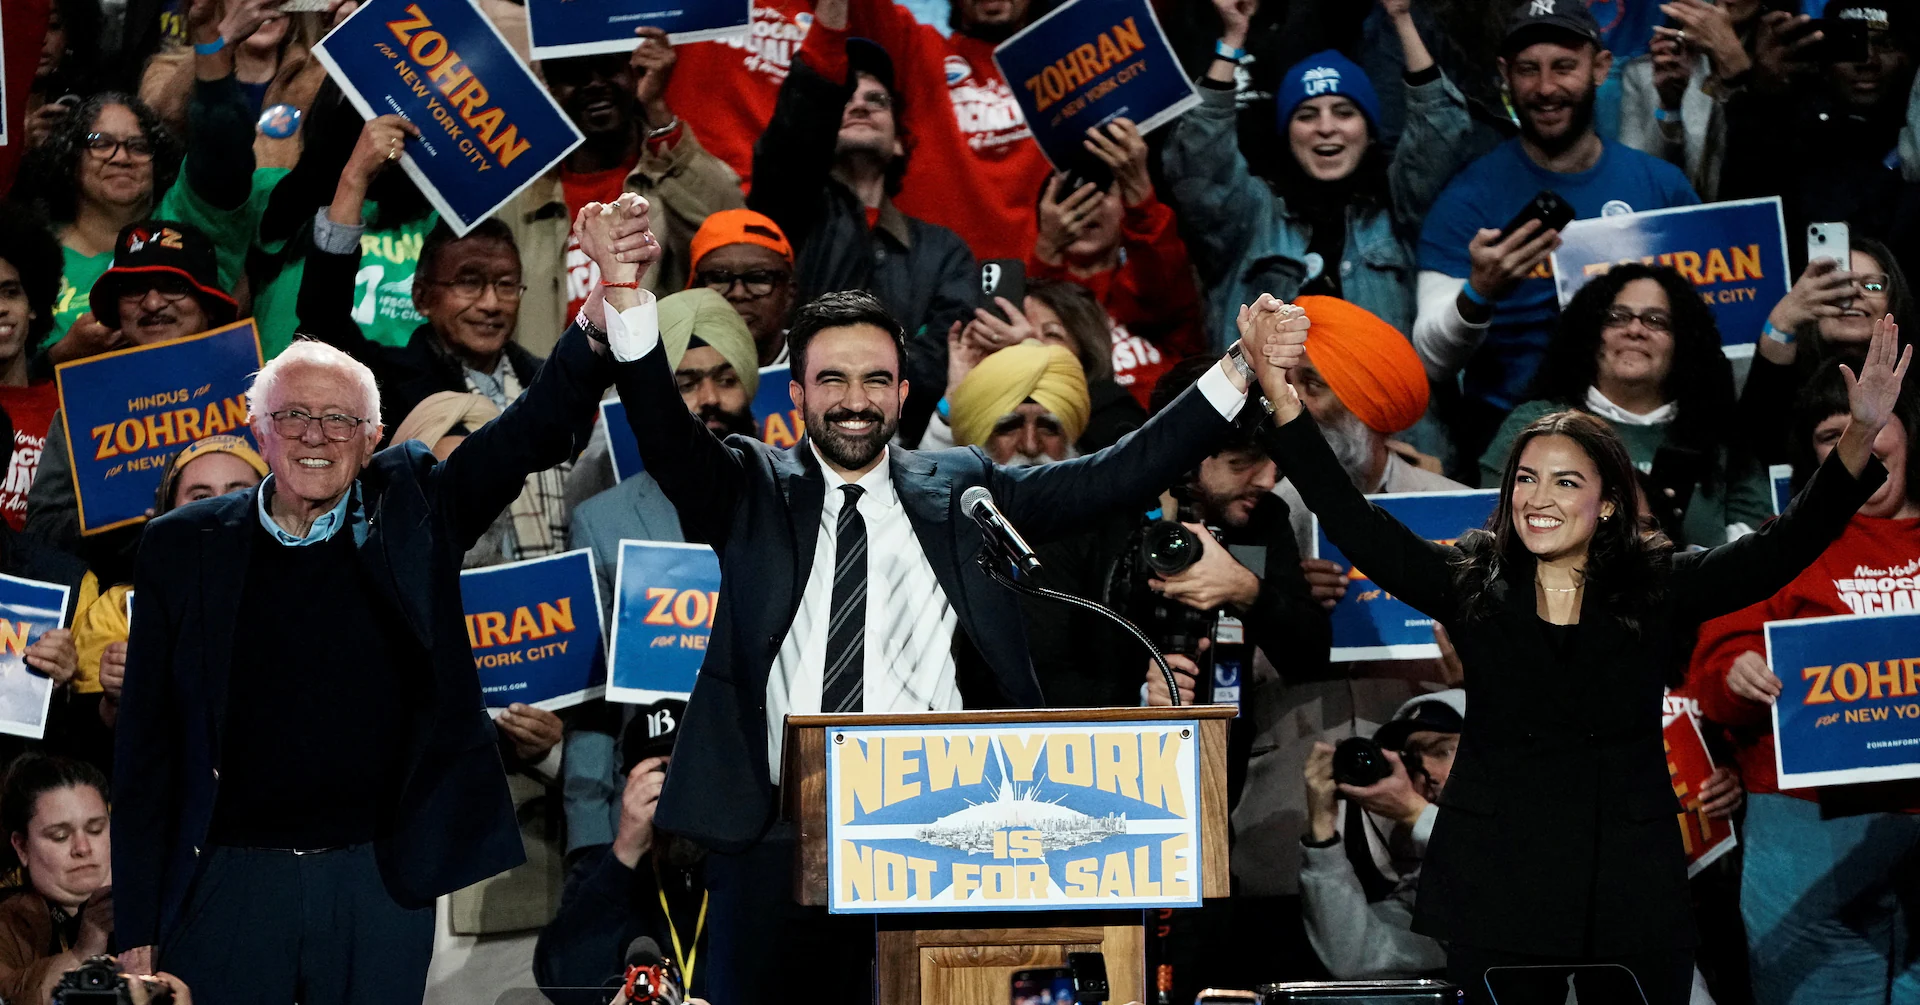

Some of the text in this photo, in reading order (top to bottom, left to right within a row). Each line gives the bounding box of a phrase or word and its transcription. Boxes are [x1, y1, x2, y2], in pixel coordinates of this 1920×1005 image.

[1025, 16, 1147, 113] ZOHRAN
[386, 3, 532, 169] ZOHRAN
[1084, 76, 1119, 103] YORK
[1117, 61, 1147, 84] CITY
[1305, 79, 1339, 96] UFT
[374, 42, 398, 60] FOR
[394, 60, 427, 98] NEW
[426, 97, 464, 141] YORK
[458, 138, 492, 173] CITY
[1718, 286, 1758, 304] CITY
[128, 383, 212, 413] HINDUS FOR
[91, 393, 250, 461] ZOHRAN
[104, 454, 167, 480] FOR NEW
[1854, 559, 1918, 577] New York
[474, 641, 569, 669] YORK CITY
[650, 634, 711, 650] FOR NE
[1815, 712, 1841, 728] FOR
[1845, 706, 1889, 724] NEW
[839, 731, 1188, 826] NEW YORK
[993, 829, 1043, 860] IS
[841, 832, 1191, 902] NOT FOR SALE
